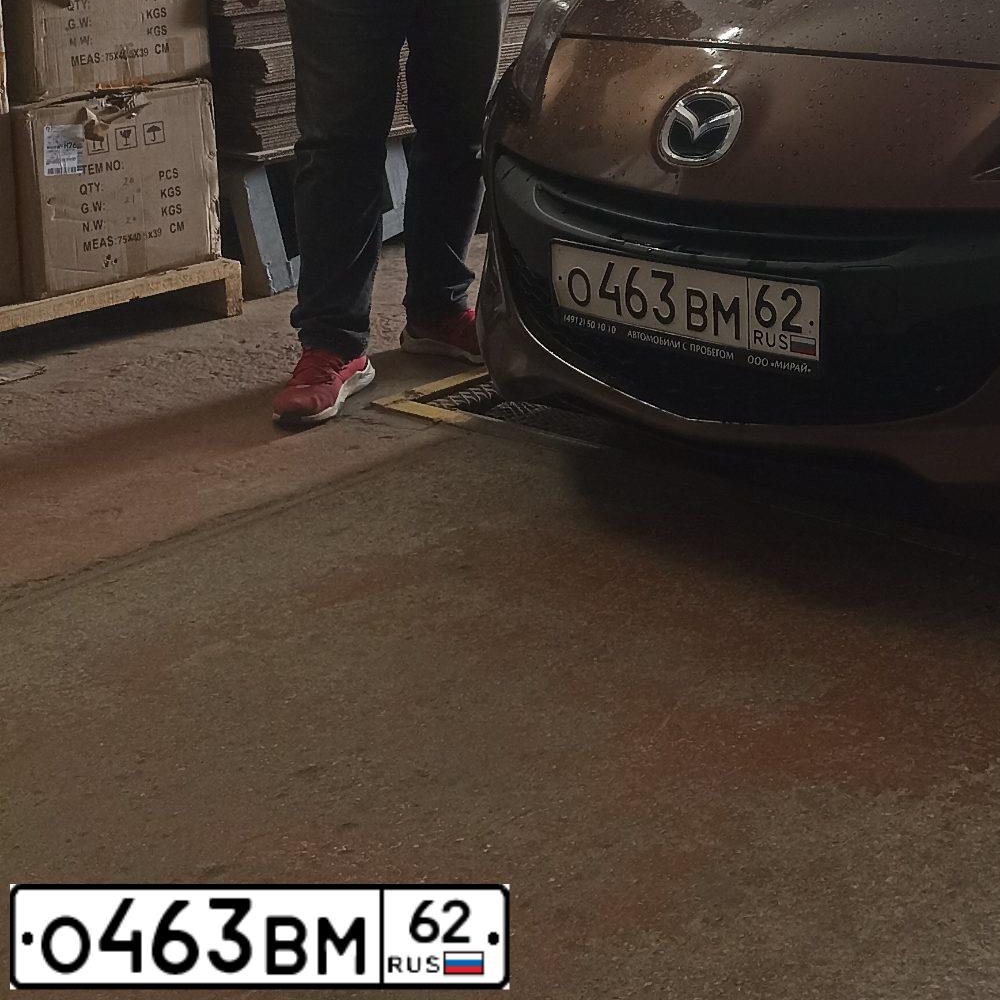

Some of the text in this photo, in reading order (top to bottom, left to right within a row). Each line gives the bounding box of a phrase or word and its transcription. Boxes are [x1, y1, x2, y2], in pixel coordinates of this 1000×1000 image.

[146, 7, 167, 20] KGS
[147, 24, 168, 37] KGS
[154, 42, 170, 55] CM
[81, 162, 104, 176] TEM
[158, 167, 179, 181] PCS
[160, 186, 182, 199] KGS
[161, 204, 183, 217] KGS
[169, 221, 185, 234] CM
[755, 284, 803, 333] 62
[586, 320, 596, 330] 50
[627, 330, 681, 349] АВТОМОБИЛИ
[682, 342, 689, 351] С
[690, 344, 735, 361] ПРОБЕГОМ
[747, 355, 769, 368] ООО
[753, 330, 788, 350] RUS
